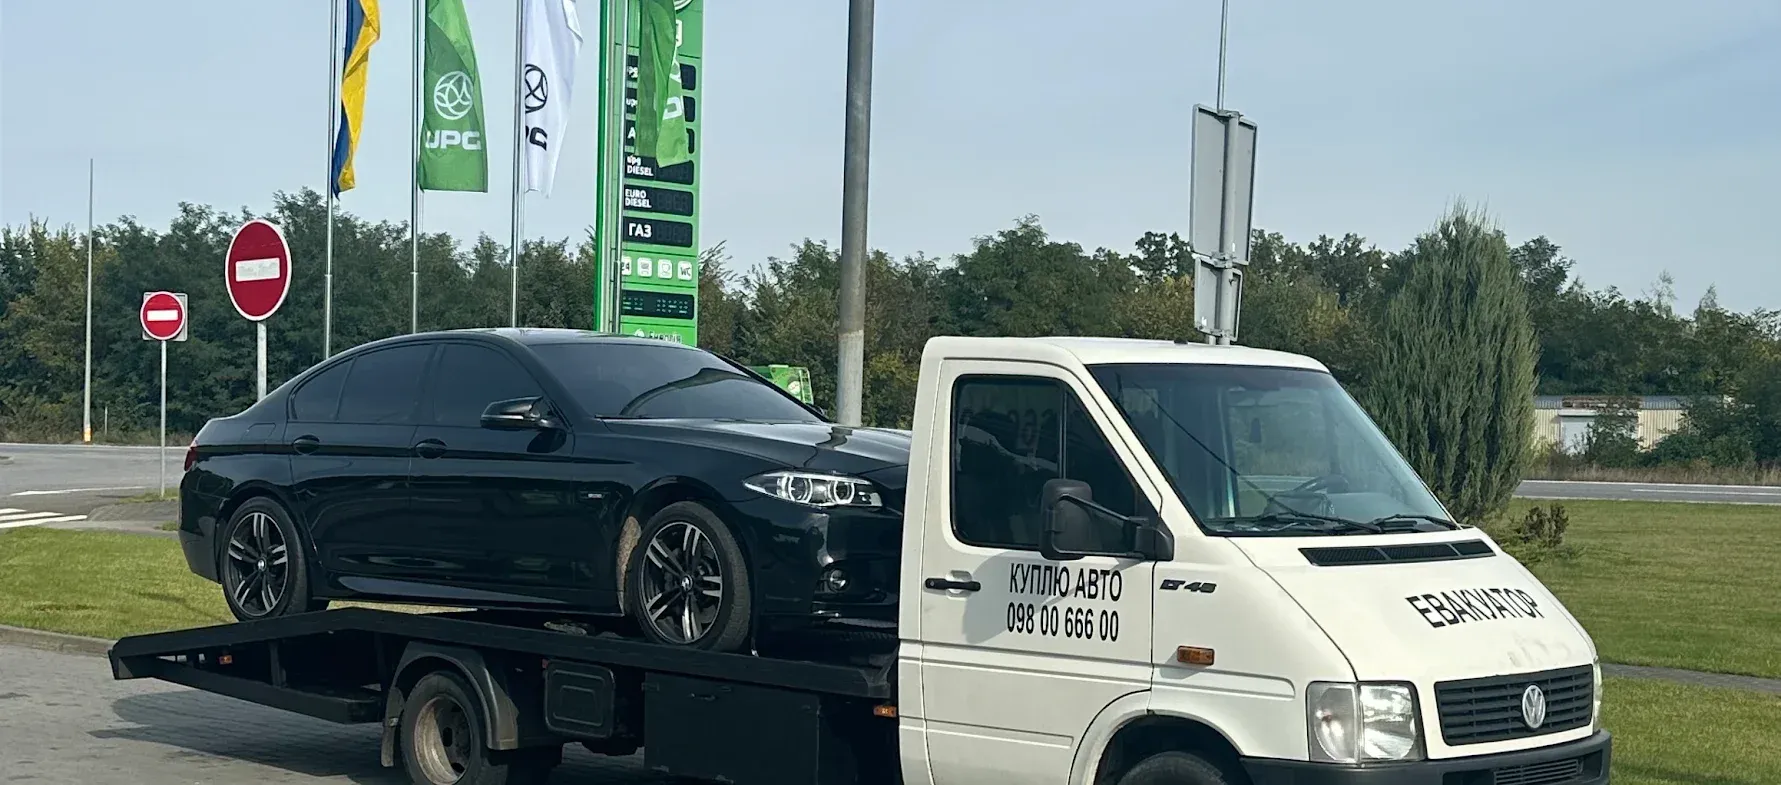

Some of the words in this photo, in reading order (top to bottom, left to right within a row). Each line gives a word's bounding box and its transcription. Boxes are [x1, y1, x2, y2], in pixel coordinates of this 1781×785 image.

[627, 165, 654, 176] DIESEL
[625, 189, 647, 199] EURO
[625, 198, 652, 208] DIESEL
[628, 223, 652, 237] ГАЗ
[680, 267, 691, 277] WC
[1009, 563, 1070, 597] КУПЛЮ
[1074, 568, 1122, 601] АВТО
[1405, 588, 1545, 628] ЕВАКУАТОР
[1007, 602, 1034, 634] 098
[1041, 605, 1059, 636] 00
[1065, 607, 1093, 639] 666
[1100, 609, 1119, 642] 00
